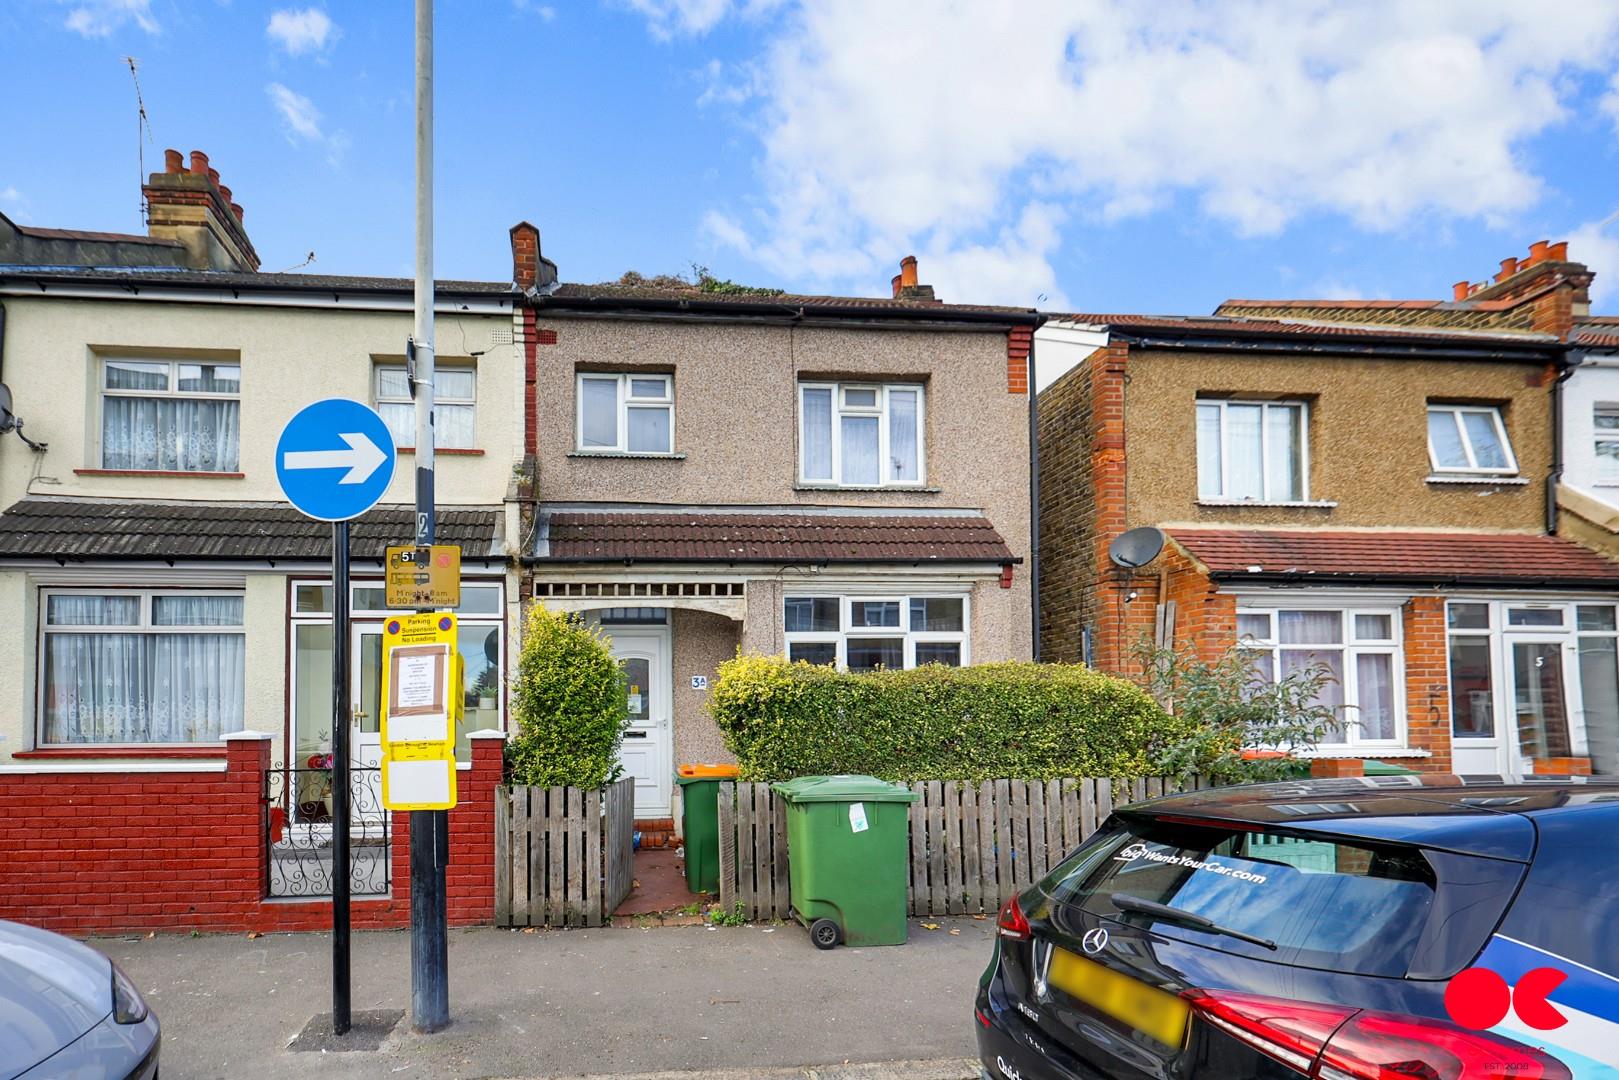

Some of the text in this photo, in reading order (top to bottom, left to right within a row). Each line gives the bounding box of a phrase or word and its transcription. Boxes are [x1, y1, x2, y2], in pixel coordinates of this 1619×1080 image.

[419, 514, 428, 535] 2
[1535, 657, 1544, 667] 5
[692, 677, 705, 687] 3A
